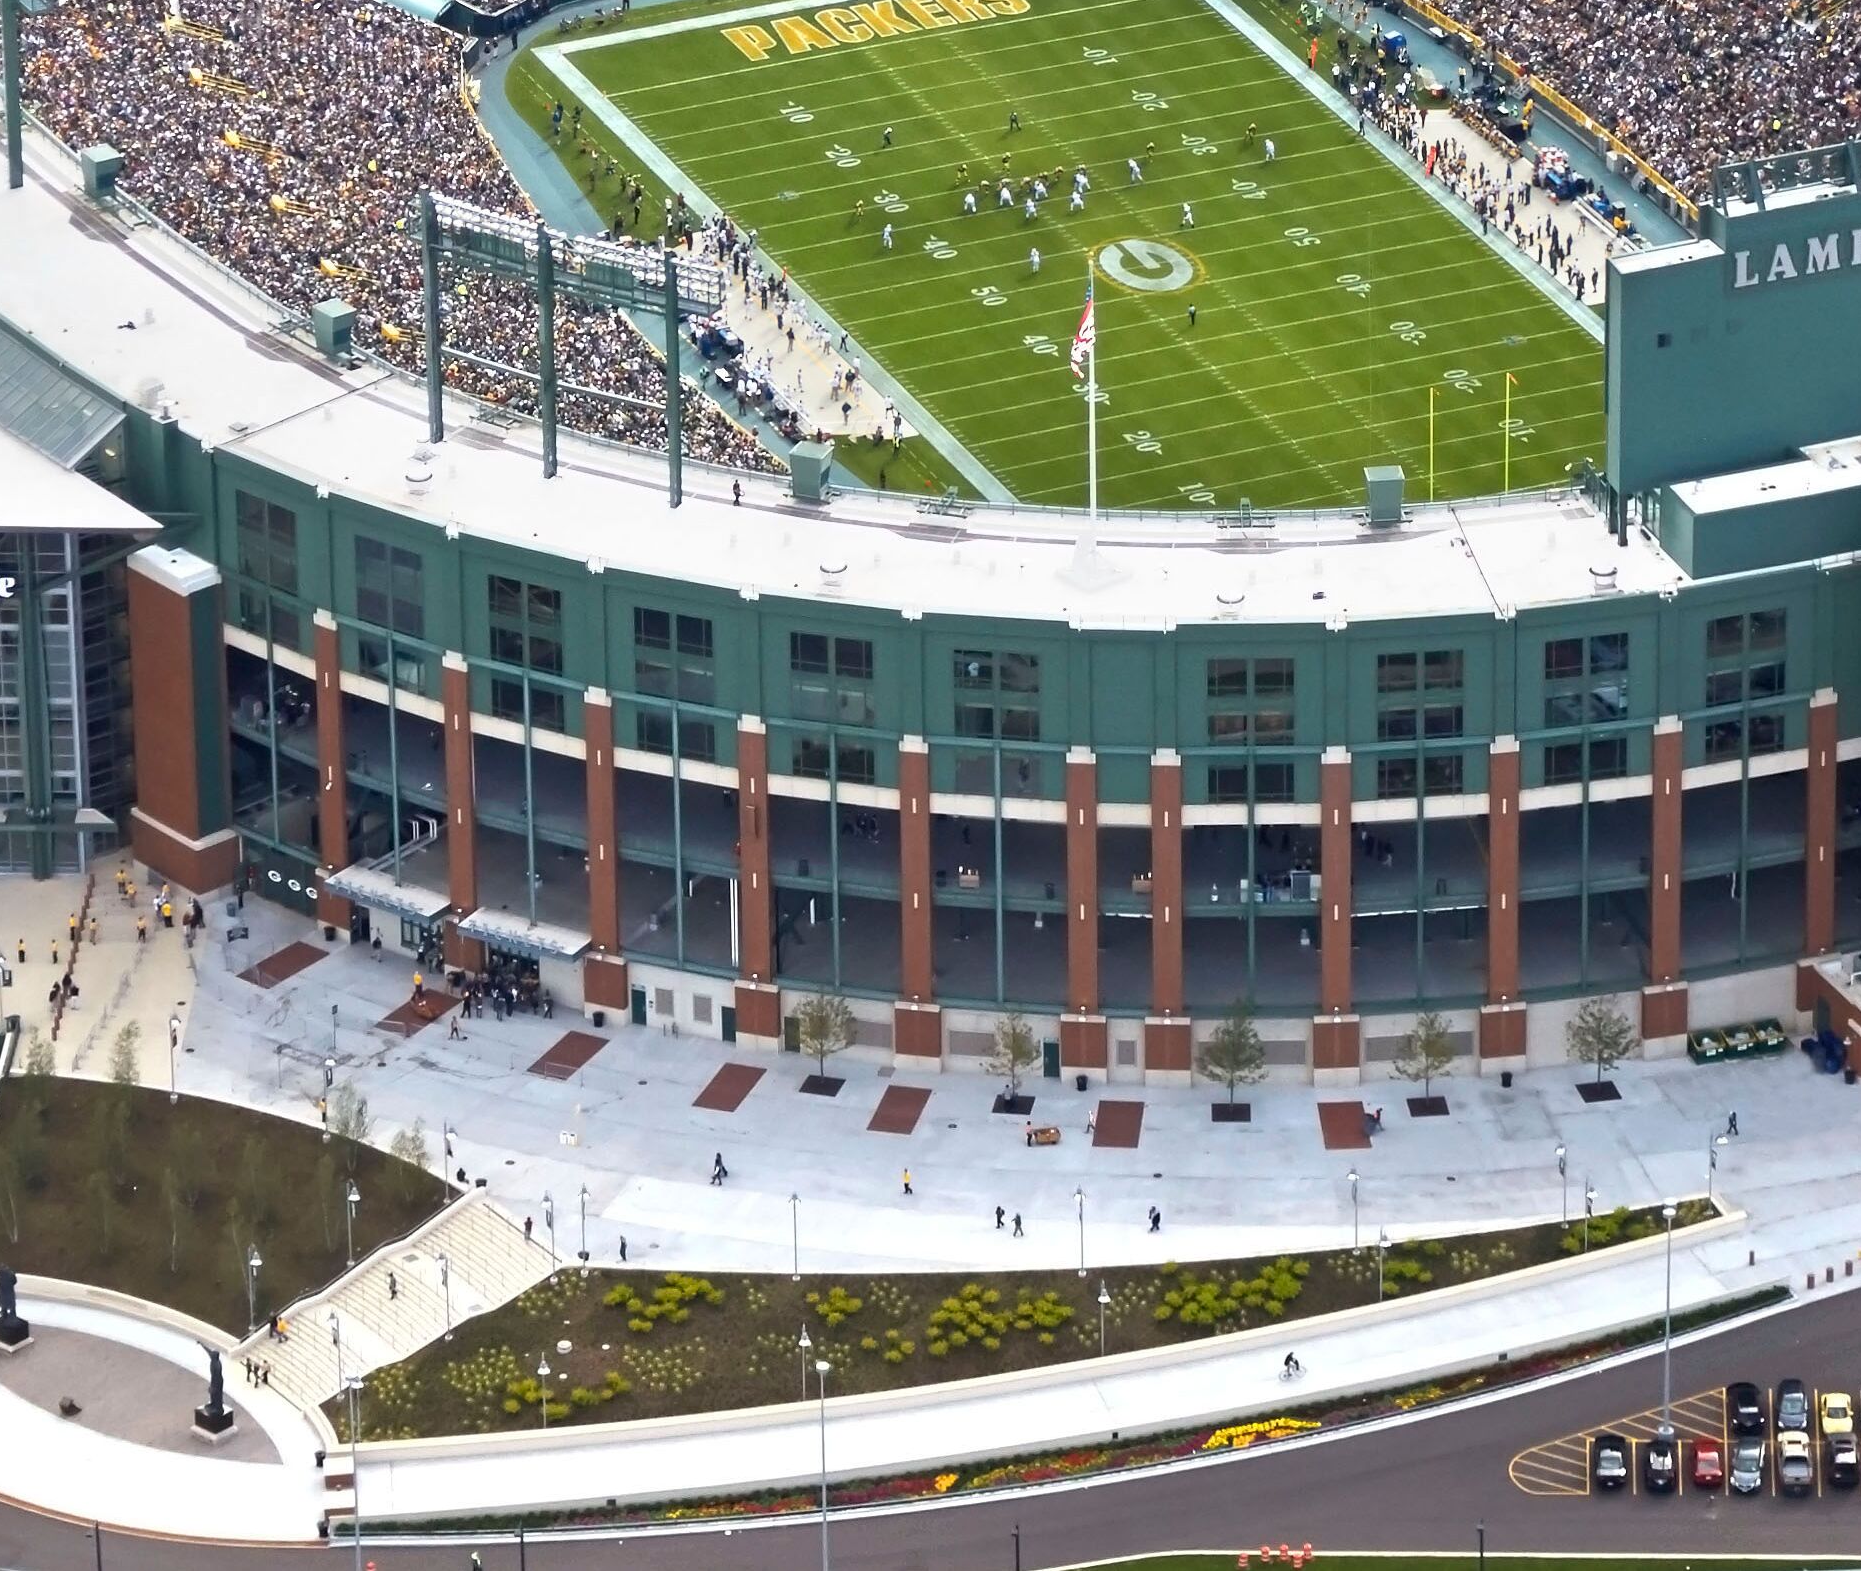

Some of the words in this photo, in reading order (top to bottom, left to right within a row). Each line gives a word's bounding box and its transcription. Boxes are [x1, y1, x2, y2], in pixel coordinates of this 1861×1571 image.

[1083, 49, 1119, 66] 10
[1133, 92, 1169, 111] 20
[779, 104, 814, 123] 10
[1183, 136, 1218, 156] 30
[826, 149, 861, 168] 20
[1233, 180, 1268, 200] 40
[874, 193, 909, 214] 30
[1284, 227, 1320, 247] 50
[923, 237, 958, 260] 40
[1098, 239, 1194, 291] G
[1336, 274, 1371, 295] 40
[971, 286, 1008, 307] 50
[1390, 321, 1427, 343] 30
[1023, 334, 1058, 355] 40
[1443, 369, 1482, 391] 20
[1123, 430, 1161, 453] 20
[1178, 482, 1214, 503] 10
